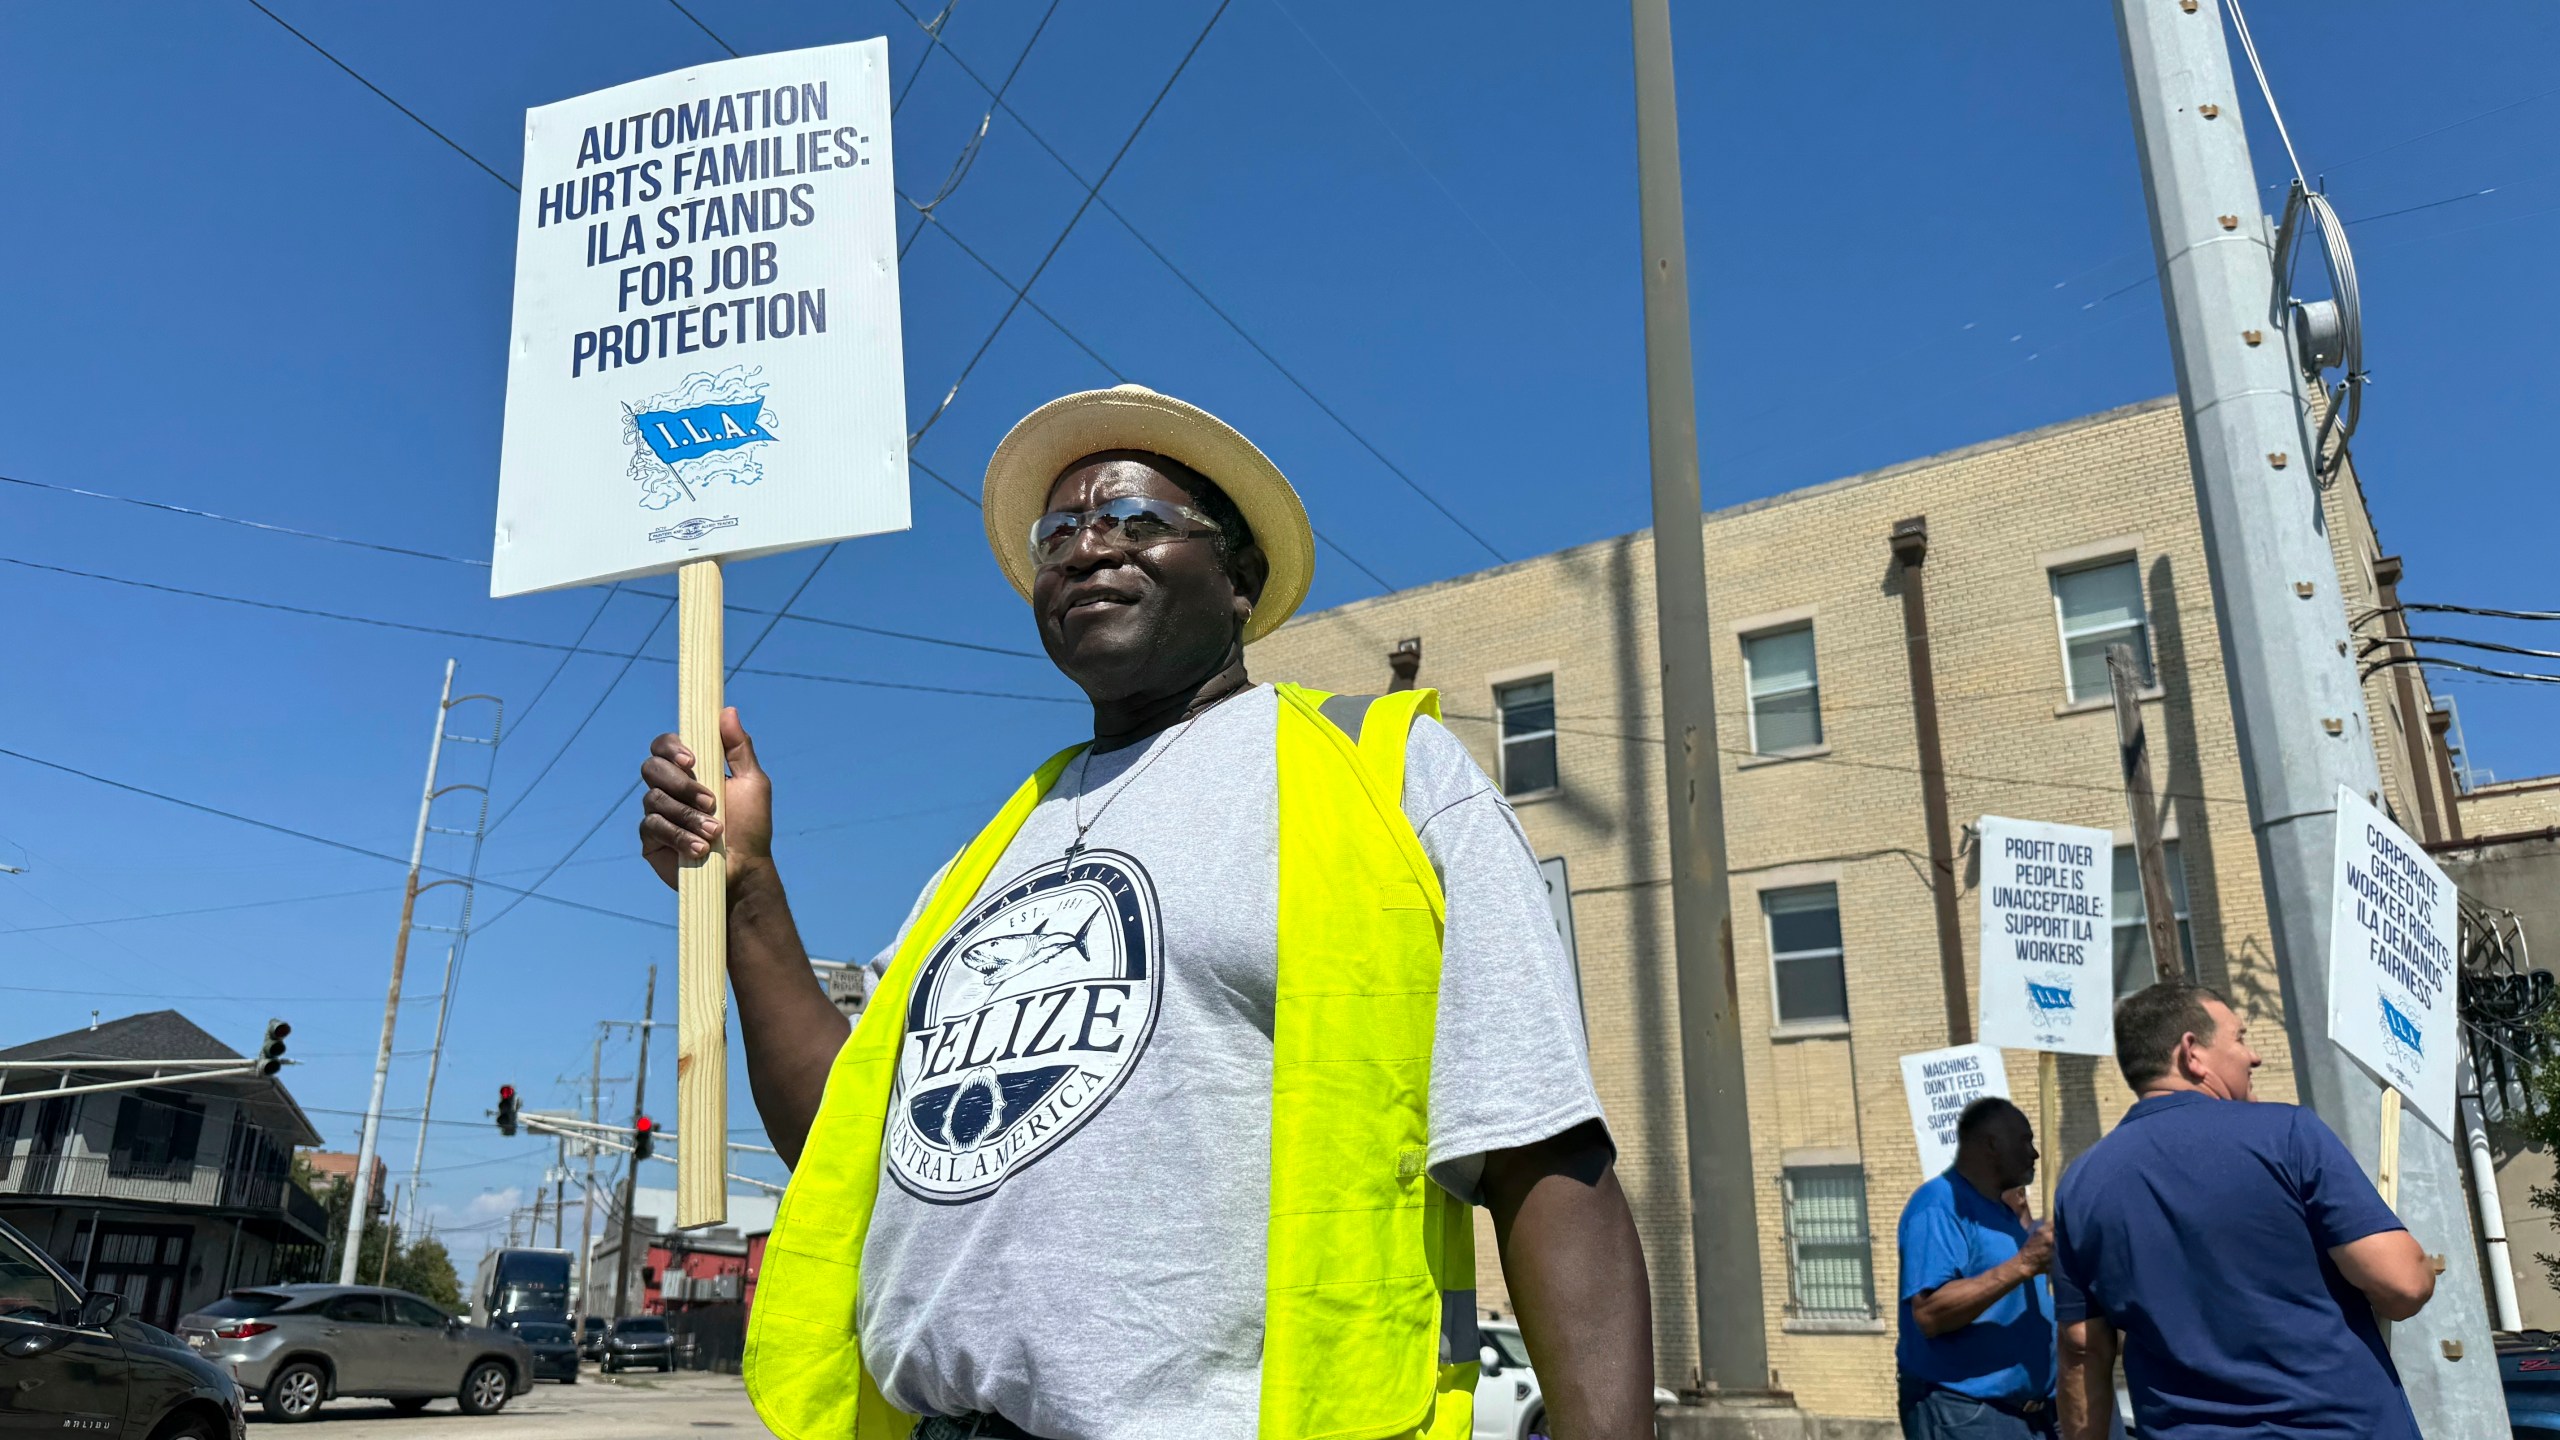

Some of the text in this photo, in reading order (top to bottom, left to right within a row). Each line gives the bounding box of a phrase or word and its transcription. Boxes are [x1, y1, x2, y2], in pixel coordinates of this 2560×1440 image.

[577, 81, 828, 169] AUTOMATION
[537, 127, 870, 228] HURTS FAMILIES:
[587, 183, 815, 267] ILA STANDS
[618, 241, 778, 312] FOR JOB
[572, 288, 826, 378] PROTECTION
[656, 415, 757, 450] I.L.A.
[2005, 838, 2093, 867] PROFIT OVER
[2015, 863, 2084, 890] PEOPLE IS
[2366, 823, 2438, 906] CORPORATE
[953, 867, 1129, 942] STAY SALTY
[1009, 907, 1045, 928] EST.
[1992, 886, 2104, 918] UNACCEPTABLE:
[2346, 861, 2453, 976] WORKER RIGHTS:
[2370, 854, 2434, 930] GREED VS.
[2005, 913, 2093, 941] SUPPORT ILA
[2015, 938, 2084, 966] WORKERS
[2356, 898, 2443, 993] ILA DEMANDS
[2369, 937, 2432, 1011] FAIRNESS
[2390, 1007, 2421, 1050] I.L.A.
[1922, 1055, 1979, 1078] MACHINES
[1923, 1072, 1985, 1096] DON'T FEED
[893, 1067, 1105, 1182] ENTRAL AMERICA
[1927, 1111, 1961, 1130] SUPPO
[63, 1419, 110, 1430] MALIBU
